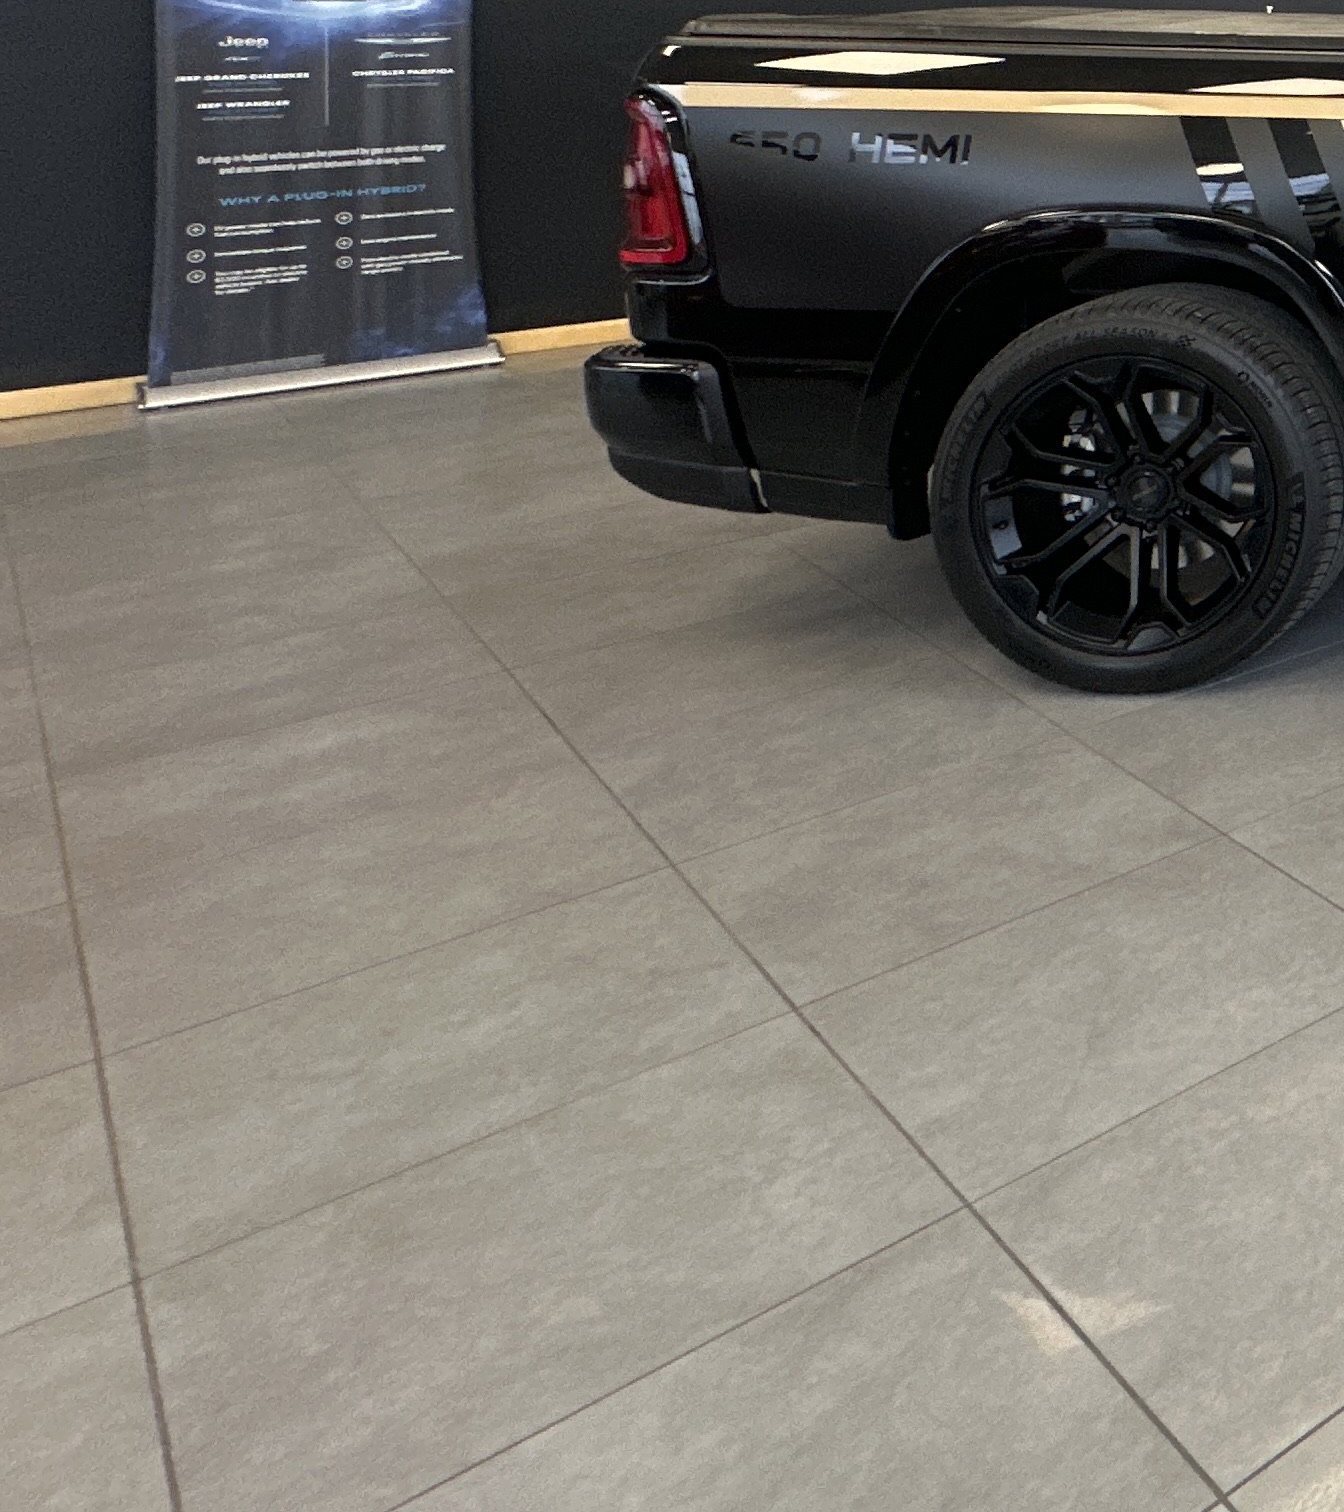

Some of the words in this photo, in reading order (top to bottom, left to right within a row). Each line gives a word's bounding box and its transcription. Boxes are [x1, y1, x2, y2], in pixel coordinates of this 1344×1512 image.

[218, 35, 269, 49] Jeep
[849, 132, 973, 166] HEMI
[219, 196, 262, 207] WHY
[267, 194, 281, 204] A
[284, 189, 353, 202] PLUG-IN
[356, 183, 427, 197] HYBRID?
[1253, 510, 1304, 617] MICHELIN
